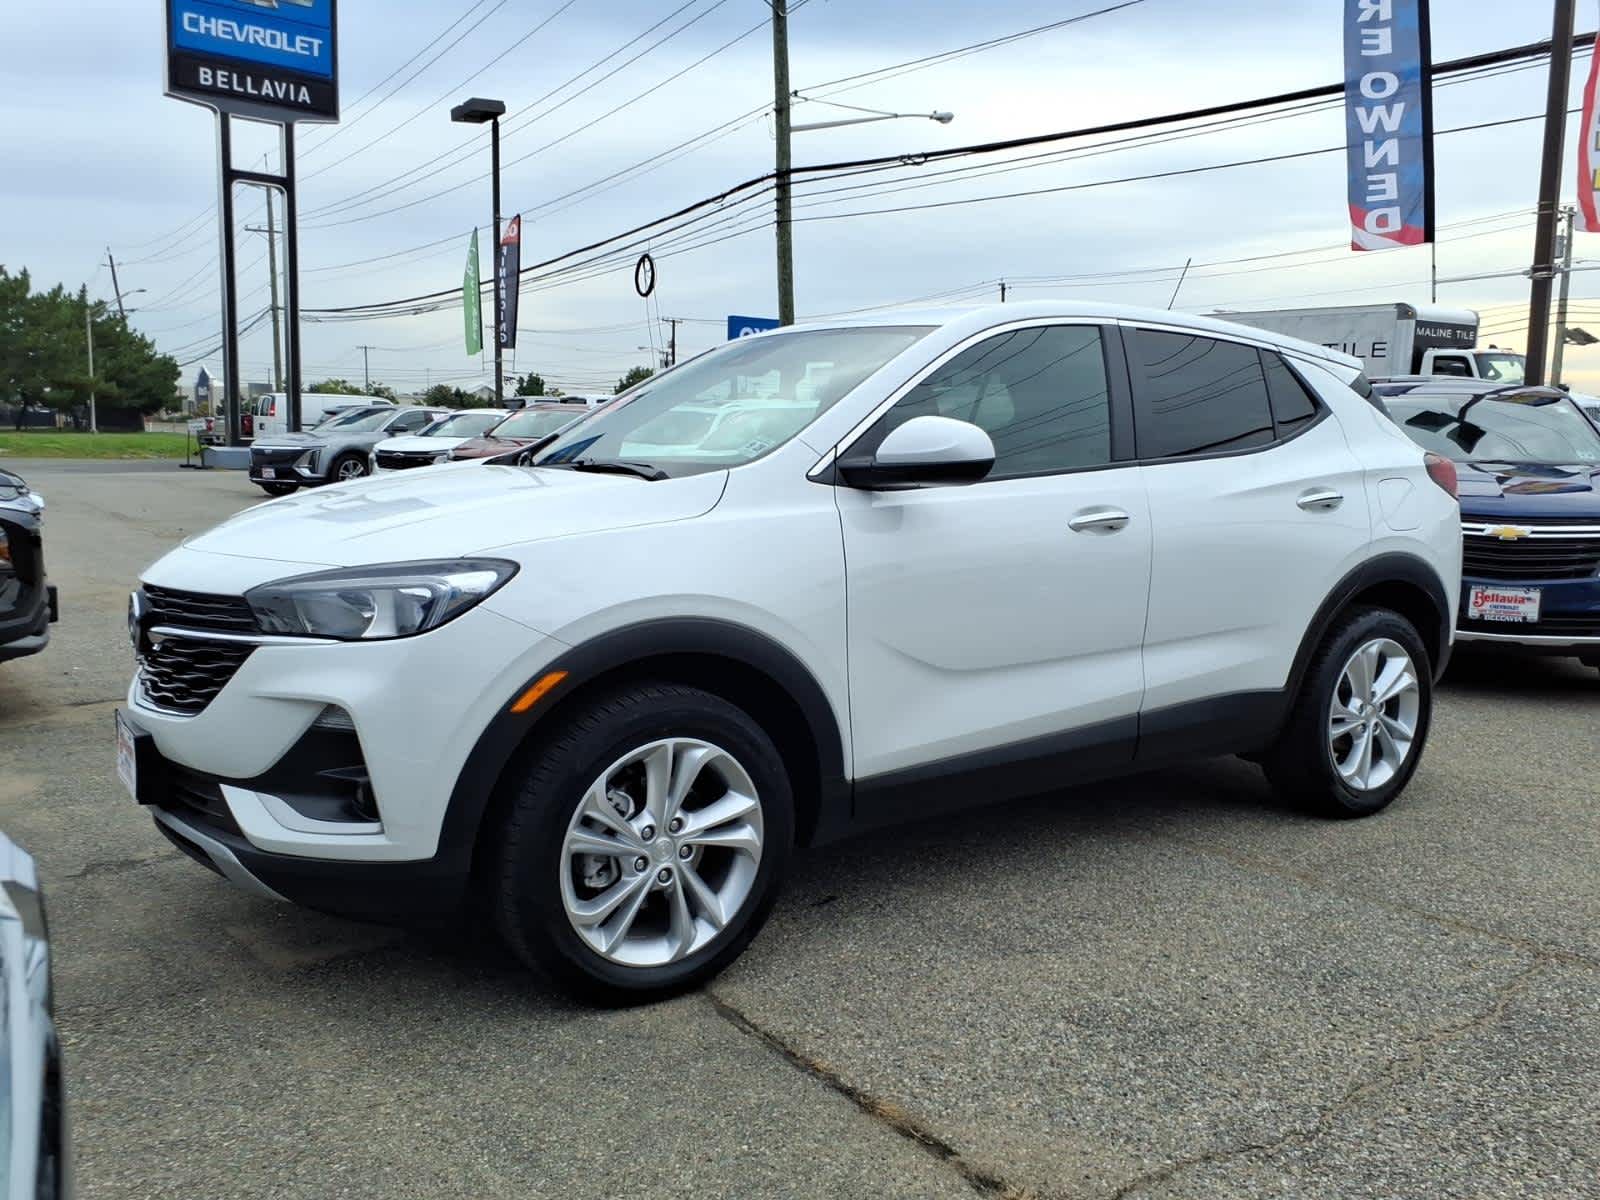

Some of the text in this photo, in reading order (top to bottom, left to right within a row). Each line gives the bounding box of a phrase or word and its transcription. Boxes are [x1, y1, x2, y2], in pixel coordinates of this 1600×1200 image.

[182, 11, 323, 57] CHEVROLET
[199, 66, 312, 104] BELLAVIA
[1416, 327, 1475, 340] MALINE TILE
[1472, 591, 1526, 607] Bellavia
